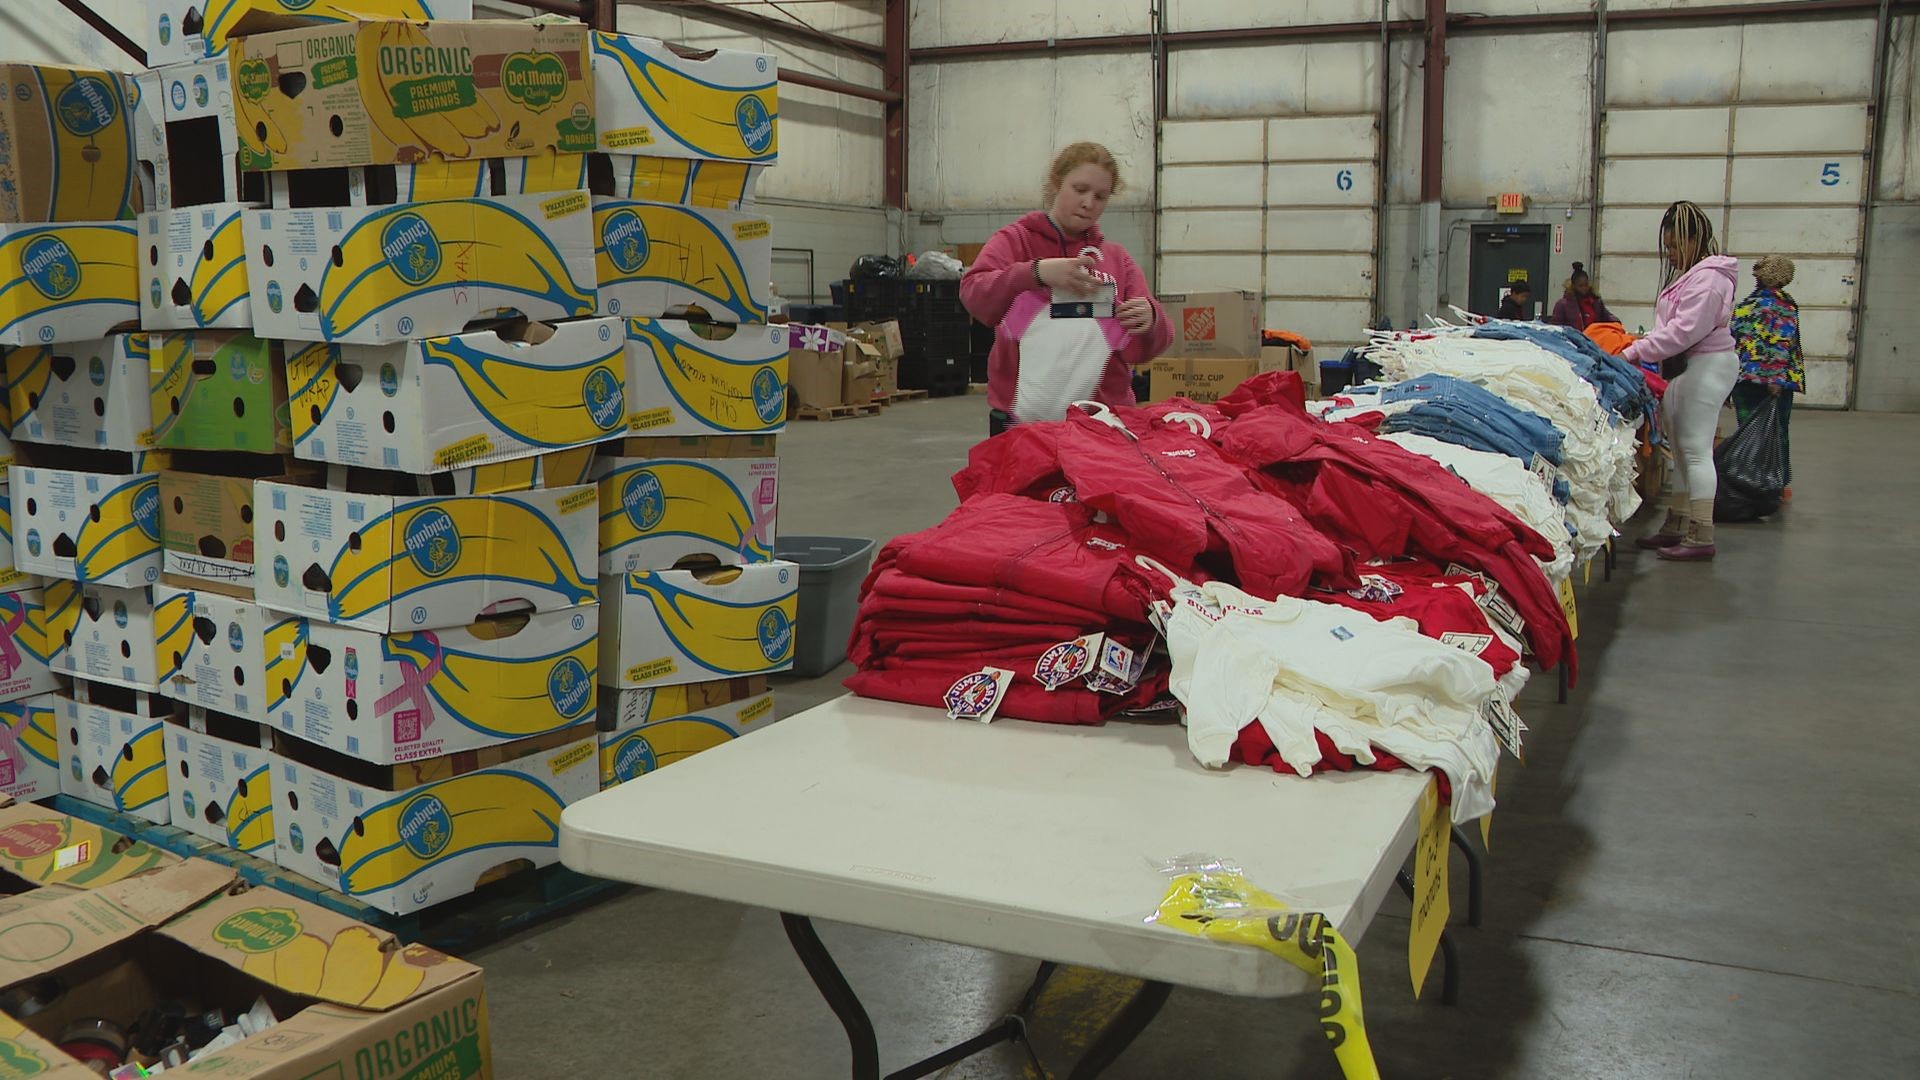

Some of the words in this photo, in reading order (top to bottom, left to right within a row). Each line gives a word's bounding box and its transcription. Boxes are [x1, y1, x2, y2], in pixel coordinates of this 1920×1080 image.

[306, 34, 356, 59] ORGANIC
[380, 46, 473, 76] ORGANIC
[409, 79, 458, 99] PREMIUM
[508, 70, 532, 86] Del
[534, 70, 563, 86] Monte
[79, 78, 112, 126] Chiquita
[411, 93, 461, 113] BANANAS
[608, 138, 629, 147] CLASS
[630, 136, 649, 144] EXTRA
[743, 119, 772, 147] Chiquita
[1338, 169, 1353, 191] 6
[1821, 163, 1840, 186] 5
[544, 199, 565, 211] EXTRA
[565, 194, 583, 207] CLASS
[1502, 194, 1520, 208] EXIT
[383, 219, 429, 259] Chiquita
[603, 216, 643, 247] Chiquita
[23, 241, 69, 275] Chiquita
[593, 389, 622, 425] Chiquita
[757, 390, 784, 418] Chiquita
[632, 420, 651, 430] CLASS
[651, 416, 670, 426] EXTRA
[623, 476, 660, 507] Chiquita
[133, 494, 160, 520] quita
[405, 513, 452, 550] Chiquita
[763, 626, 791, 658] Chiquita
[1038, 646, 1066, 672] JUMP
[1071, 648, 1089, 677] BALL
[633, 671, 652, 681] CLASS
[652, 666, 672, 677] EXTRA
[951, 675, 982, 697] JUMP
[10, 683, 31, 692] EXTRA
[556, 677, 591, 714] Chiquita
[977, 682, 996, 711] BALL
[394, 743, 421, 753] SELECTED
[421, 739, 444, 748] QUALITY
[394, 751, 418, 761] CLASS
[419, 746, 442, 757] EXTRA
[615, 739, 649, 773] Chiquita
[15, 787, 36, 797] EXTRA
[400, 798, 443, 840] Chiquita
[227, 916, 270, 938] Monte
[260, 930, 287, 945] Del
[355, 997, 477, 1080] ORGANIC
